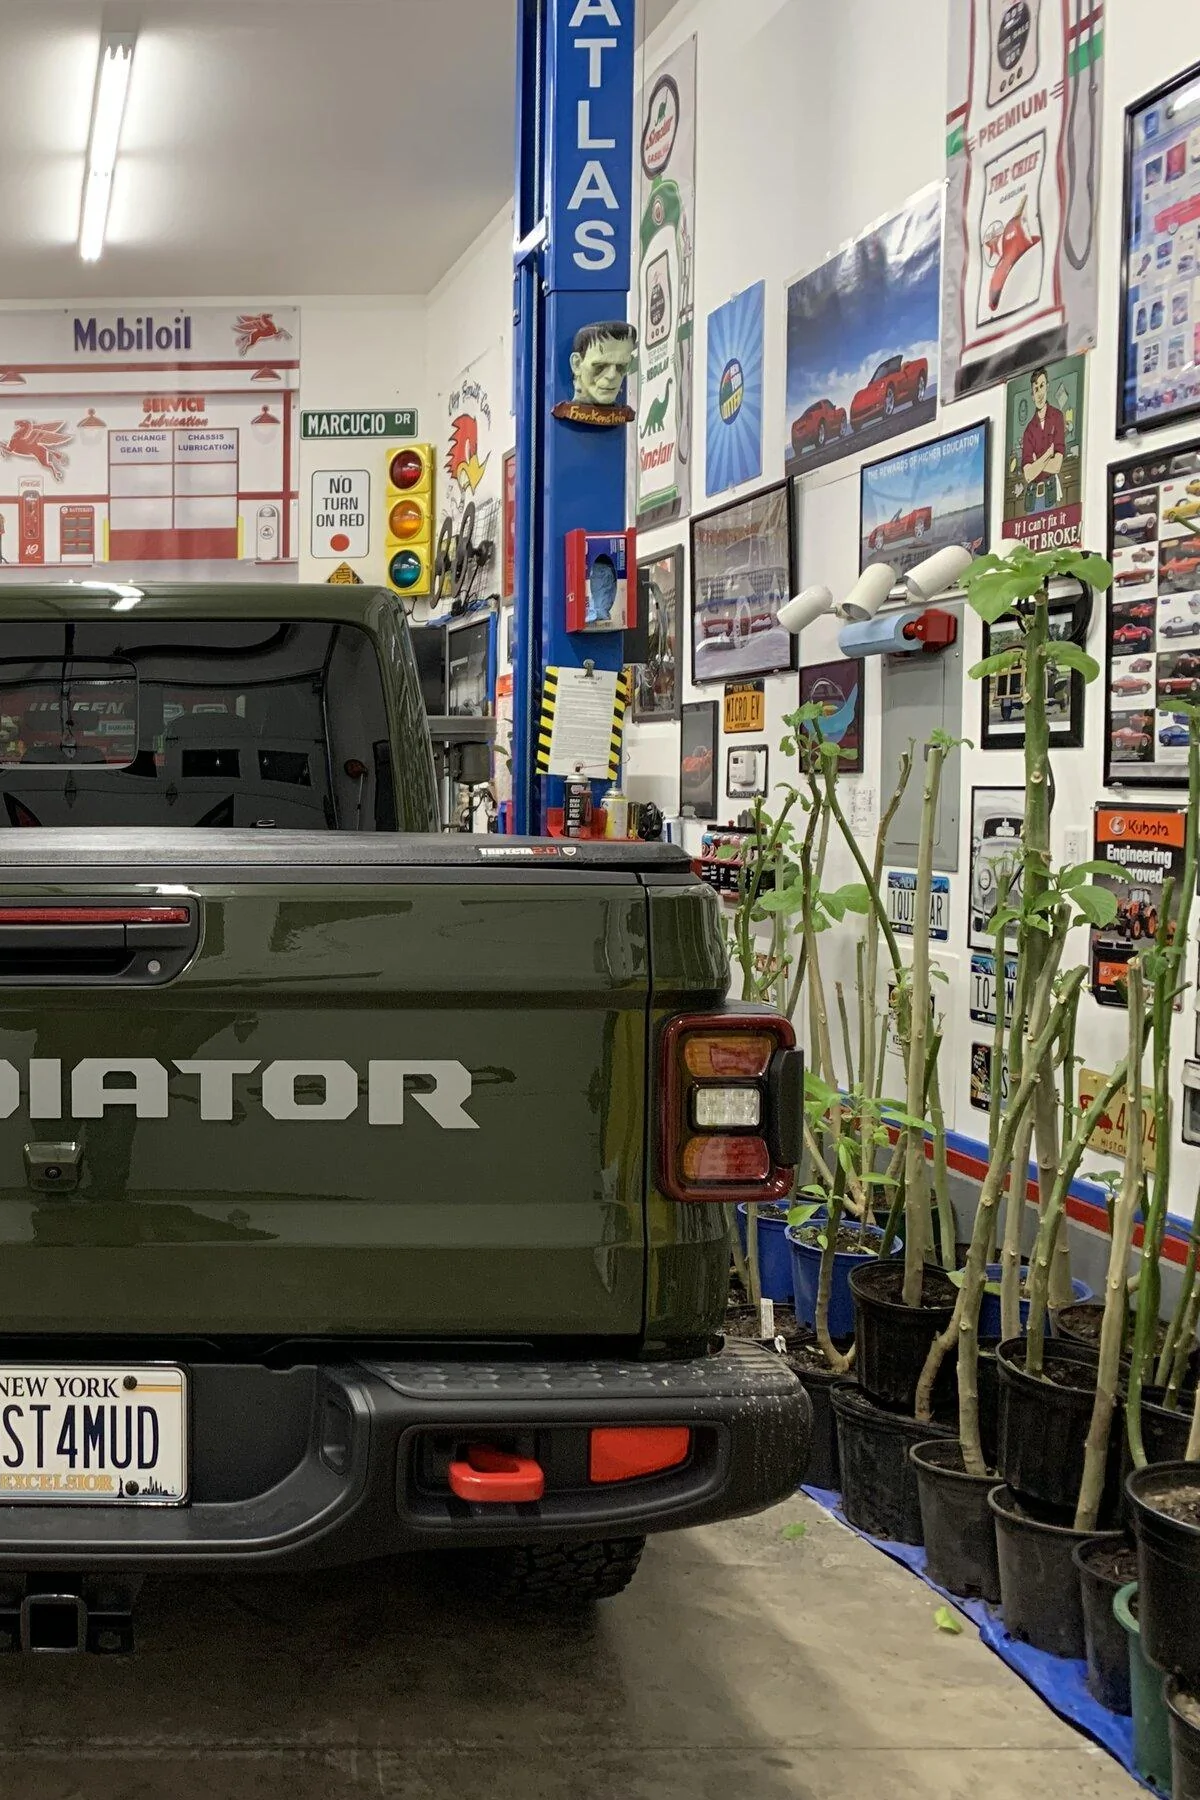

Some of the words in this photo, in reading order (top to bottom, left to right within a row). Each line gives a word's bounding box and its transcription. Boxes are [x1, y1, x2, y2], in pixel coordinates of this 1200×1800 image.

[978, 88, 1048, 148] PREMIUM
[566, 0, 622, 271] ATLAS
[988, 165, 1010, 196] FIRE
[1010, 150, 1041, 181] CHIEF
[73, 316, 192, 351] Mobiloil
[142, 398, 205, 412] SERVICE
[139, 413, 208, 428] Lubrication
[307, 413, 386, 435] MARCUCIO
[394, 413, 411, 424] DR
[115, 434, 131, 442] OIL
[132, 434, 167, 442] CHANGE
[177, 443, 235, 452] LUBRICATION
[188, 433, 224, 441] CHASSIS
[918, 446, 941, 462] HIGHER
[942, 433, 980, 456] EDUCATION
[120, 446, 143, 454] GEAR
[146, 446, 160, 454] OIL
[641, 441, 675, 472] Sinclair
[329, 477, 352, 493] NO
[323, 497, 358, 510] TURN
[316, 514, 334, 527] ON
[339, 513, 365, 527] RED
[1014, 522, 1021, 537] If
[1028, 516, 1046, 532] can't
[1047, 514, 1057, 530] fix
[1059, 511, 1067, 525] it
[1041, 520, 1084, 549] BROKE!
[726, 696, 747, 722] MICRO
[751, 694, 760, 720] EV
[1128, 819, 1170, 837] Kubota
[1106, 843, 1173, 869] Engineering
[54, 1376, 120, 1398] YORK
